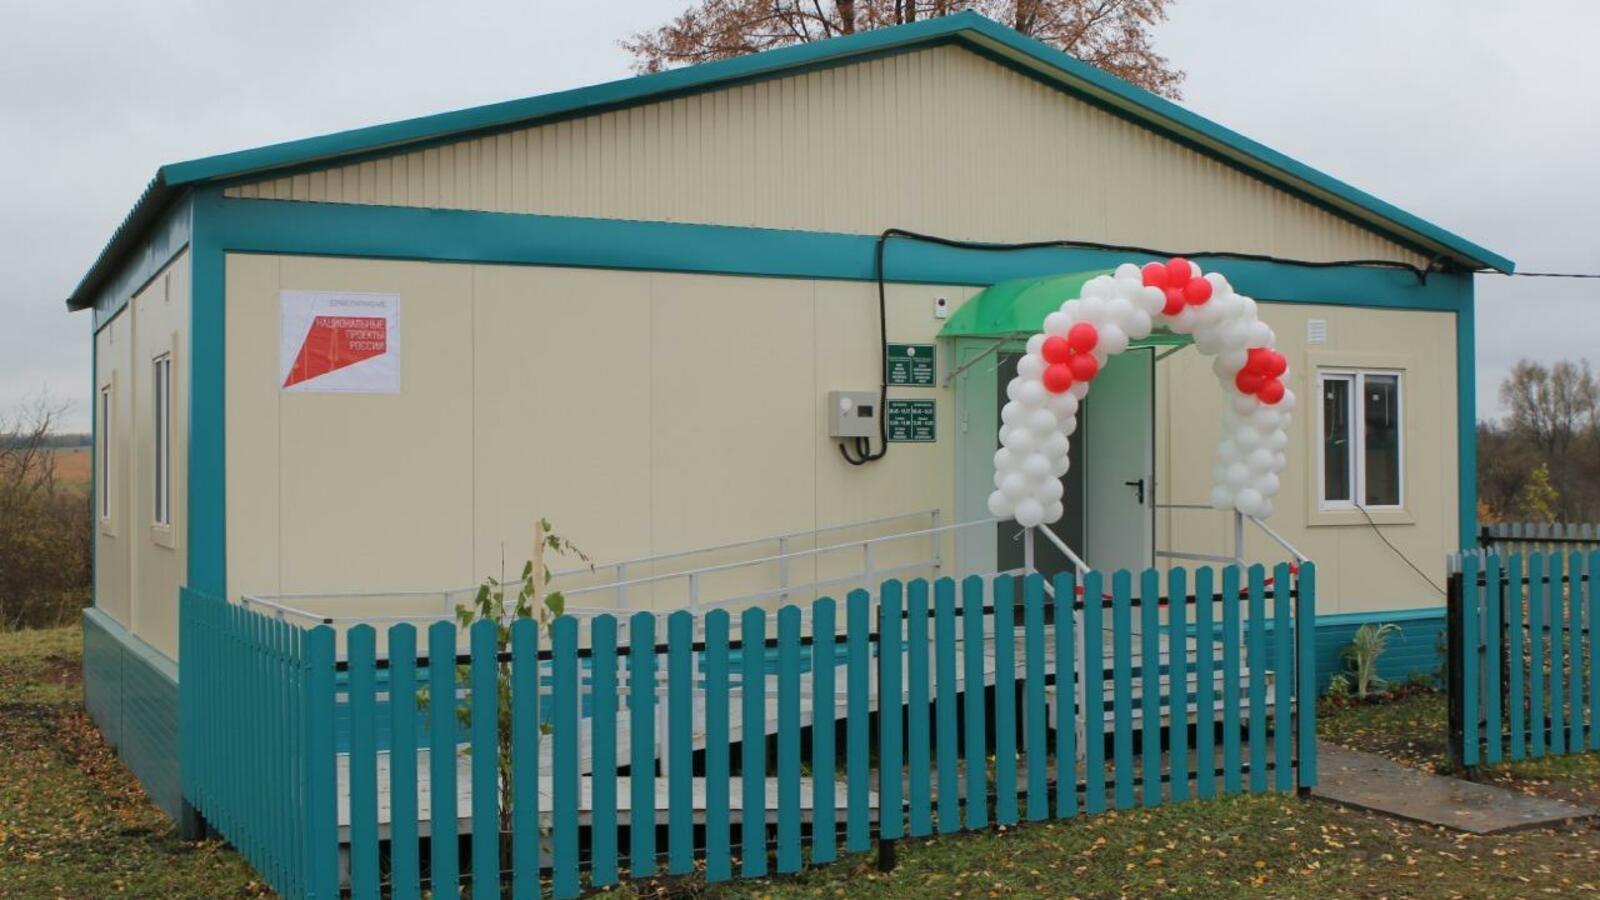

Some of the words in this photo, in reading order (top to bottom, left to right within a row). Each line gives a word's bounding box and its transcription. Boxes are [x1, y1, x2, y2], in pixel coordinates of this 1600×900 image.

[316, 319, 385, 329] НАЦИОНАЛЬНЫЕ
[346, 330, 385, 340] ПРОЕКТЫ
[350, 340, 385, 350] РОССИИ
